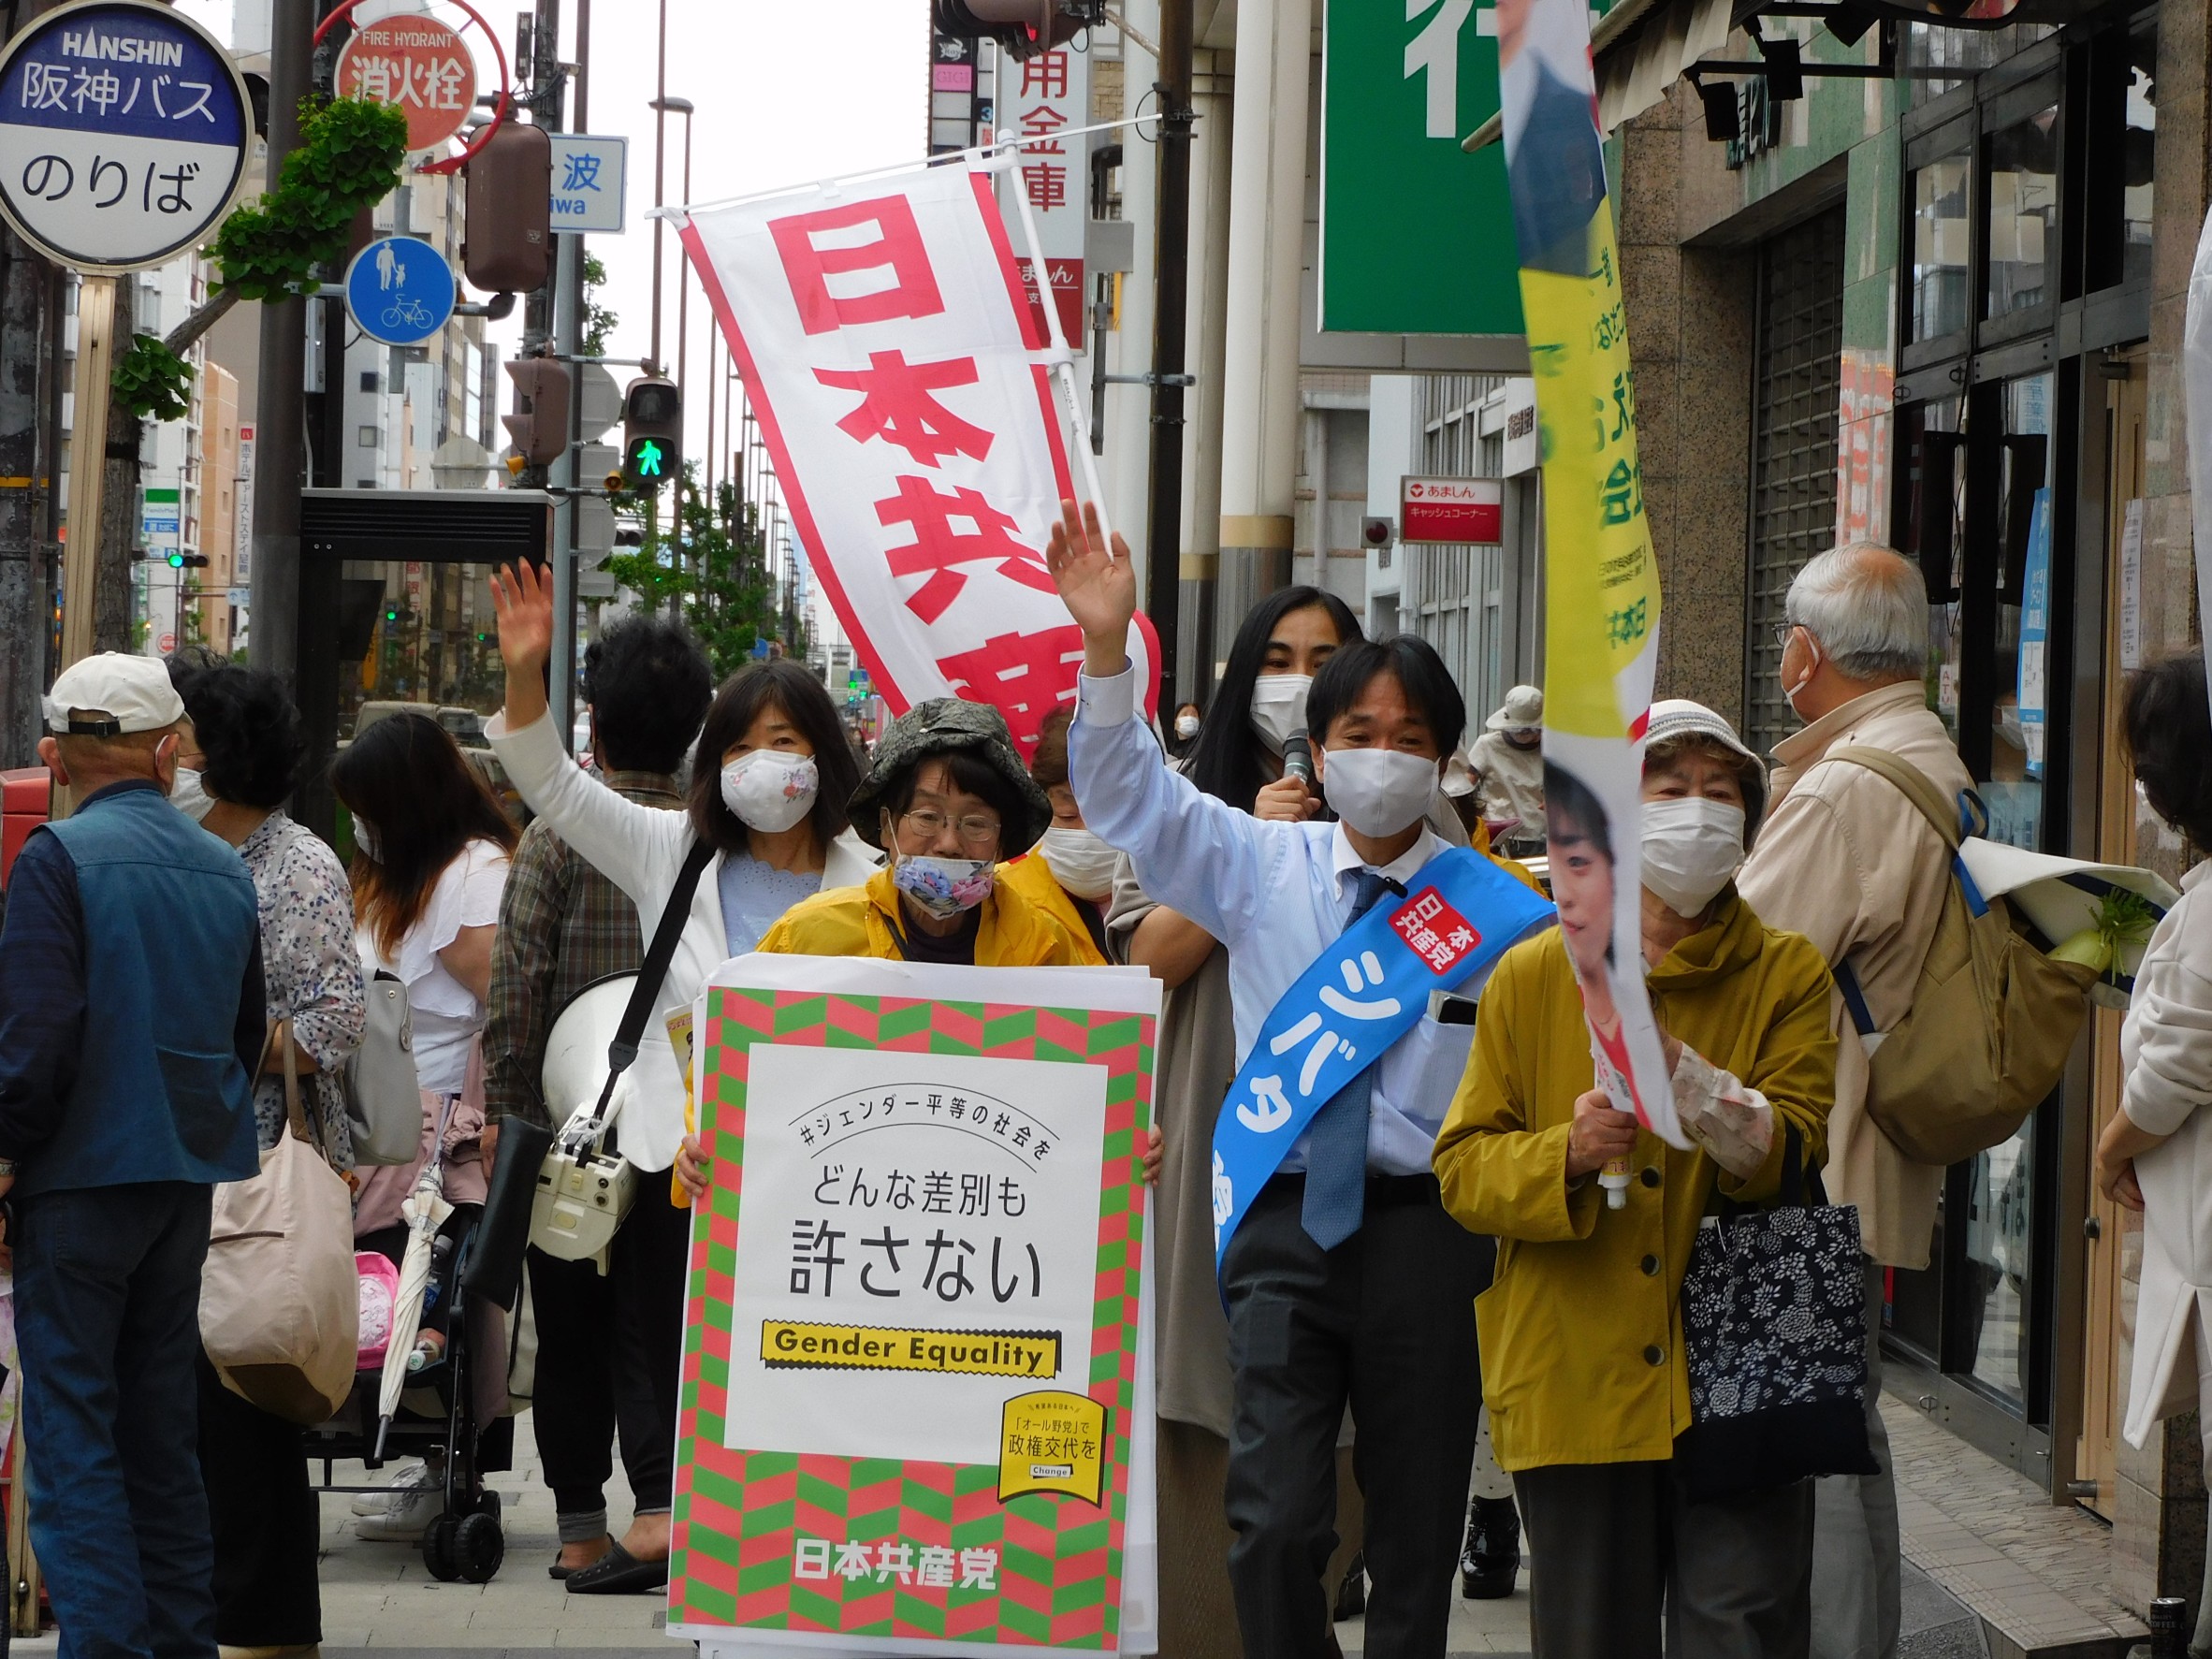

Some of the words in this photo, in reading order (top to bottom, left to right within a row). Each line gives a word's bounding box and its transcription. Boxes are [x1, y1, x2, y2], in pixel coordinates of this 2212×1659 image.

[62, 25, 183, 67] HANSHIN
[362, 31, 390, 47] FIRE
[394, 32, 455, 48] HYDRANT
[22, 62, 216, 124] 阪神バス
[351, 54, 467, 110] 消火栓
[936, 70, 969, 85] GIGI
[22, 154, 201, 214] のりば
[1410, 506, 1489, 519] キャッシュコーナー
[1427, 485, 1476, 499] あましん
[1235, 950, 1402, 1134] シバタ
[799, 1093, 1052, 1162] #ジェンダー平等の社会を
[813, 1164, 1026, 1217] どんな差別も
[790, 1218, 1041, 1304] 許さない
[774, 1328, 896, 1360] Gender
[909, 1334, 1044, 1372] Equality
[1008, 1433, 1097, 1460] 政権交代を
[1015, 1417, 1090, 1434] 「オール野党」で
[1033, 1466, 1068, 1477] Change
[793, 1538, 998, 1591] 日本共産党
